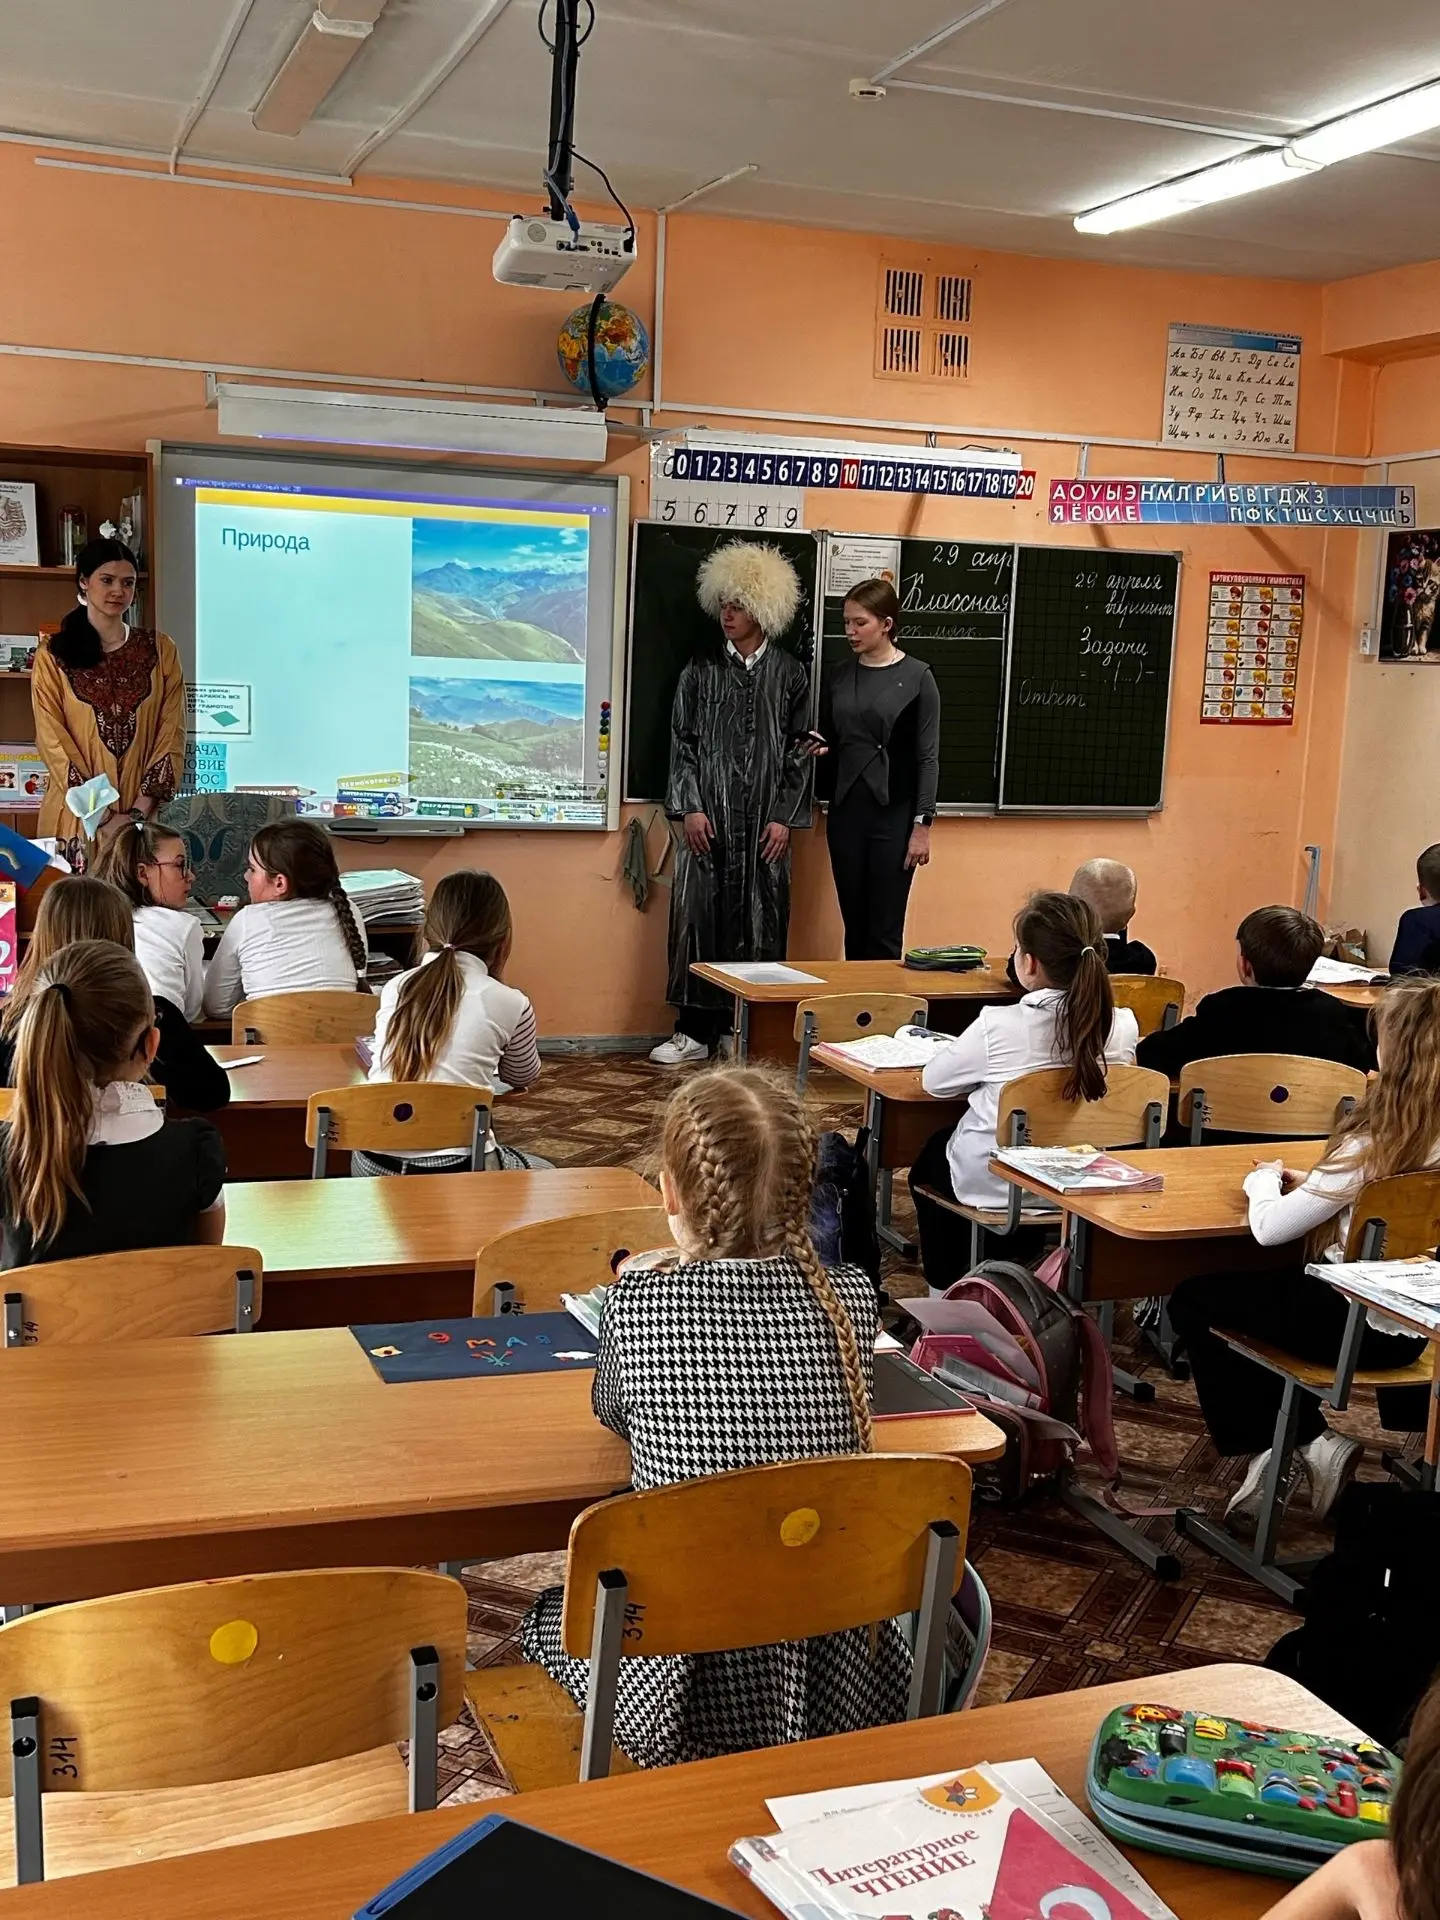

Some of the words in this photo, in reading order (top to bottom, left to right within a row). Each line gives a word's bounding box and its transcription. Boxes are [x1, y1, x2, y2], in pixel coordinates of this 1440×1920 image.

[677, 455, 688, 470] 0
[695, 455, 703, 476] 1
[710, 456, 722, 477] 2
[728, 457, 738, 478] 3
[745, 458, 755, 479] 4
[762, 459, 772, 480] 5
[778, 460, 789, 481] 6
[796, 461, 806, 482] 7
[811, 462, 822, 483] 8
[828, 463, 839, 484] 9
[843, 464, 857, 485] 10
[861, 464, 875, 486] 11
[879, 465, 893, 487] 12
[897, 467, 911, 488] 13
[915, 468, 930, 489] 14
[933, 469, 948, 490] 15
[951, 471, 965, 492] 16
[968, 472, 982, 493] 17
[985, 473, 999, 494] 18
[1002, 474, 1016, 495] 19
[1017, 475, 1034, 496] 20
[1052, 484, 1066, 500] А
[1070, 484, 1085, 500] О
[1087, 485, 1101, 501] У
[1106, 485, 1121, 500] Ы
[1125, 485, 1136, 500] Э
[1141, 485, 1153, 500] Н
[1157, 485, 1173, 501] М
[1176, 485, 1188, 501] Л
[1196, 486, 1205, 501] Р
[1229, 488, 1239, 502] Б
[1247, 488, 1256, 503] В
[1265, 488, 1273, 503] Г
[1279, 488, 1292, 505] Д
[1295, 489, 1310, 504] Ж
[1314, 489, 1324, 504] З
[1401, 490, 1410, 504] Ь
[662, 501, 677, 521] 5
[695, 502, 707, 523] 6
[726, 504, 737, 525] 7
[754, 505, 767, 527] 8
[784, 507, 798, 528] 9
[1053, 505, 1063, 521] Я
[1072, 503, 1082, 521] Ё
[1088, 505, 1104, 521] Ю
[1106, 505, 1119, 520] И
[1126, 505, 1135, 521] Е
[1230, 508, 1242, 521] П
[1247, 507, 1261, 522] Ф
[1265, 508, 1277, 522] К
[1281, 508, 1292, 522] Т
[1297, 508, 1312, 522] Ш
[1316, 509, 1327, 522] С
[1333, 509, 1344, 522] Х
[1349, 509, 1363, 524] Ц
[1365, 509, 1376, 523] Ч
[1380, 509, 1396, 525] Щ
[1399, 510, 1410, 523] Ъ
[222, 528, 310, 554] Природа
[932, 544, 960, 566] 29
[971, 551, 1012, 585] апр
[901, 572, 1010, 612] Классная
[1075, 572, 1098, 588] 29
[1106, 574, 1163, 603] апреля
[1080, 626, 1148, 666] Задачи
[185, 743, 219, 756] ДАЧА
[183, 772, 220, 785] ПРОС
[621, 1602, 647, 1641] 314
[49, 1737, 78, 1779] 314
[807, 1829, 980, 1887] Литературное
[849, 1850, 976, 1898] ЧТЕНИЕ
